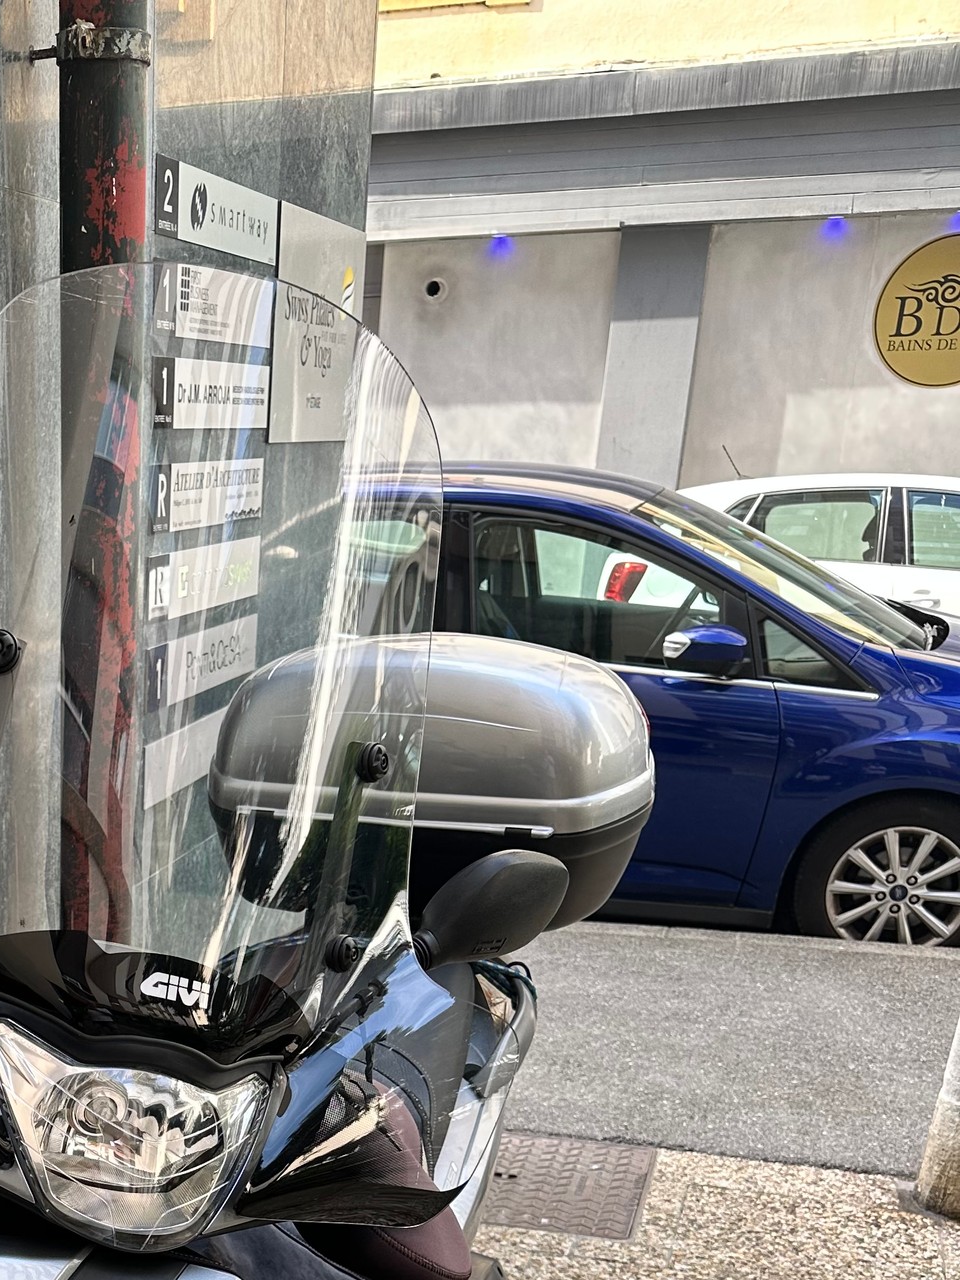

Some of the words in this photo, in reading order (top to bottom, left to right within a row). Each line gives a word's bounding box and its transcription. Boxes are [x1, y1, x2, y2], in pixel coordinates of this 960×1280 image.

[163, 168, 173, 214] 2
[210, 202, 269, 245] smartway
[163, 268, 170, 313] 1
[313, 335, 332, 378] Yoga
[887, 338, 933, 352] BAINS
[936, 338, 958, 351] DE
[162, 367, 168, 405] 1
[177, 383, 187, 404] Dr
[202, 385, 231, 405] ARROJA
[157, 473, 167, 518] R
[172, 468, 205, 493] ATELIER
[154, 567, 164, 606] R
[156, 657, 162, 700] 1
[140, 971, 211, 1010] GIVI
